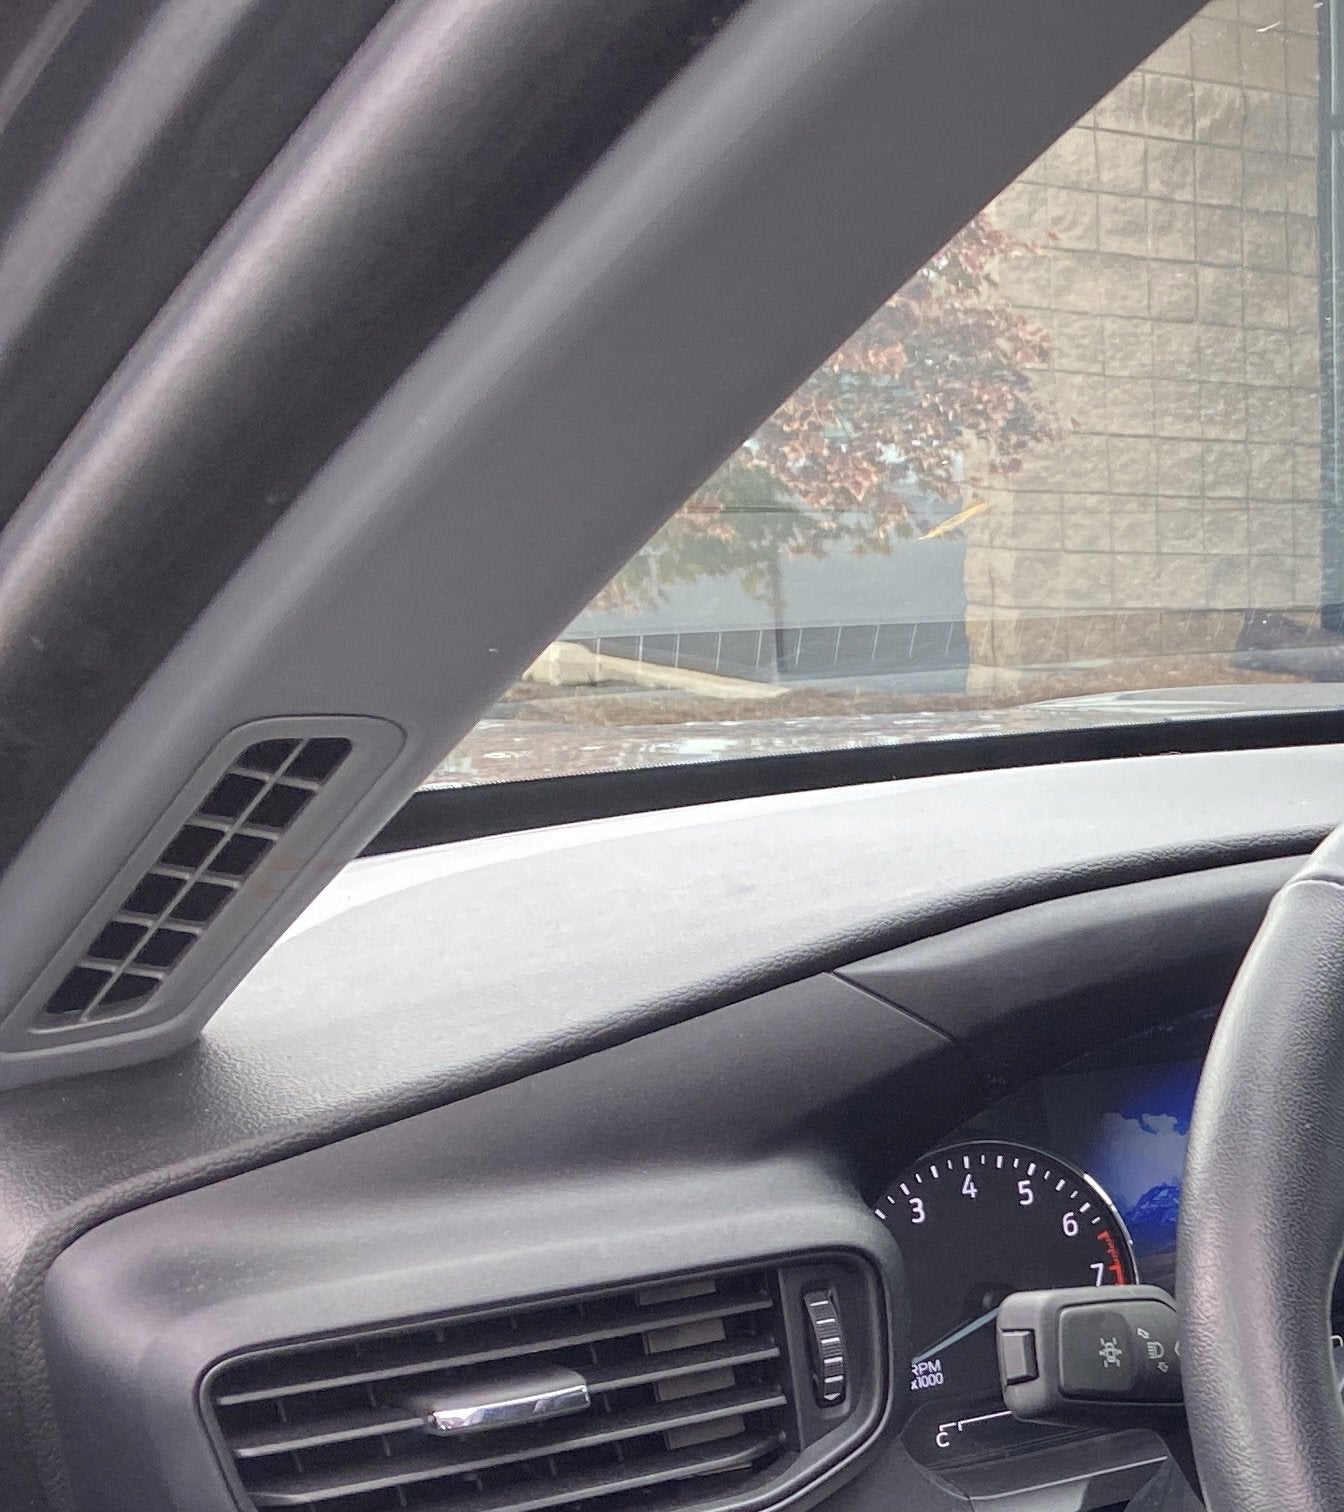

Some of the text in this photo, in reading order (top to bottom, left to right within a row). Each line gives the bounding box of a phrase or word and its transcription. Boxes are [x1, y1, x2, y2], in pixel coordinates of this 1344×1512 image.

[961, 1173, 978, 1198] 4
[1017, 1180, 1034, 1205] 5
[909, 1197, 926, 1224] 3
[1062, 1211, 1079, 1236] 6
[1090, 1262, 1104, 1287] 7
[911, 1359, 942, 1377] RPM
[910, 1372, 945, 1390] x1000
[935, 1431, 950, 1448] C
